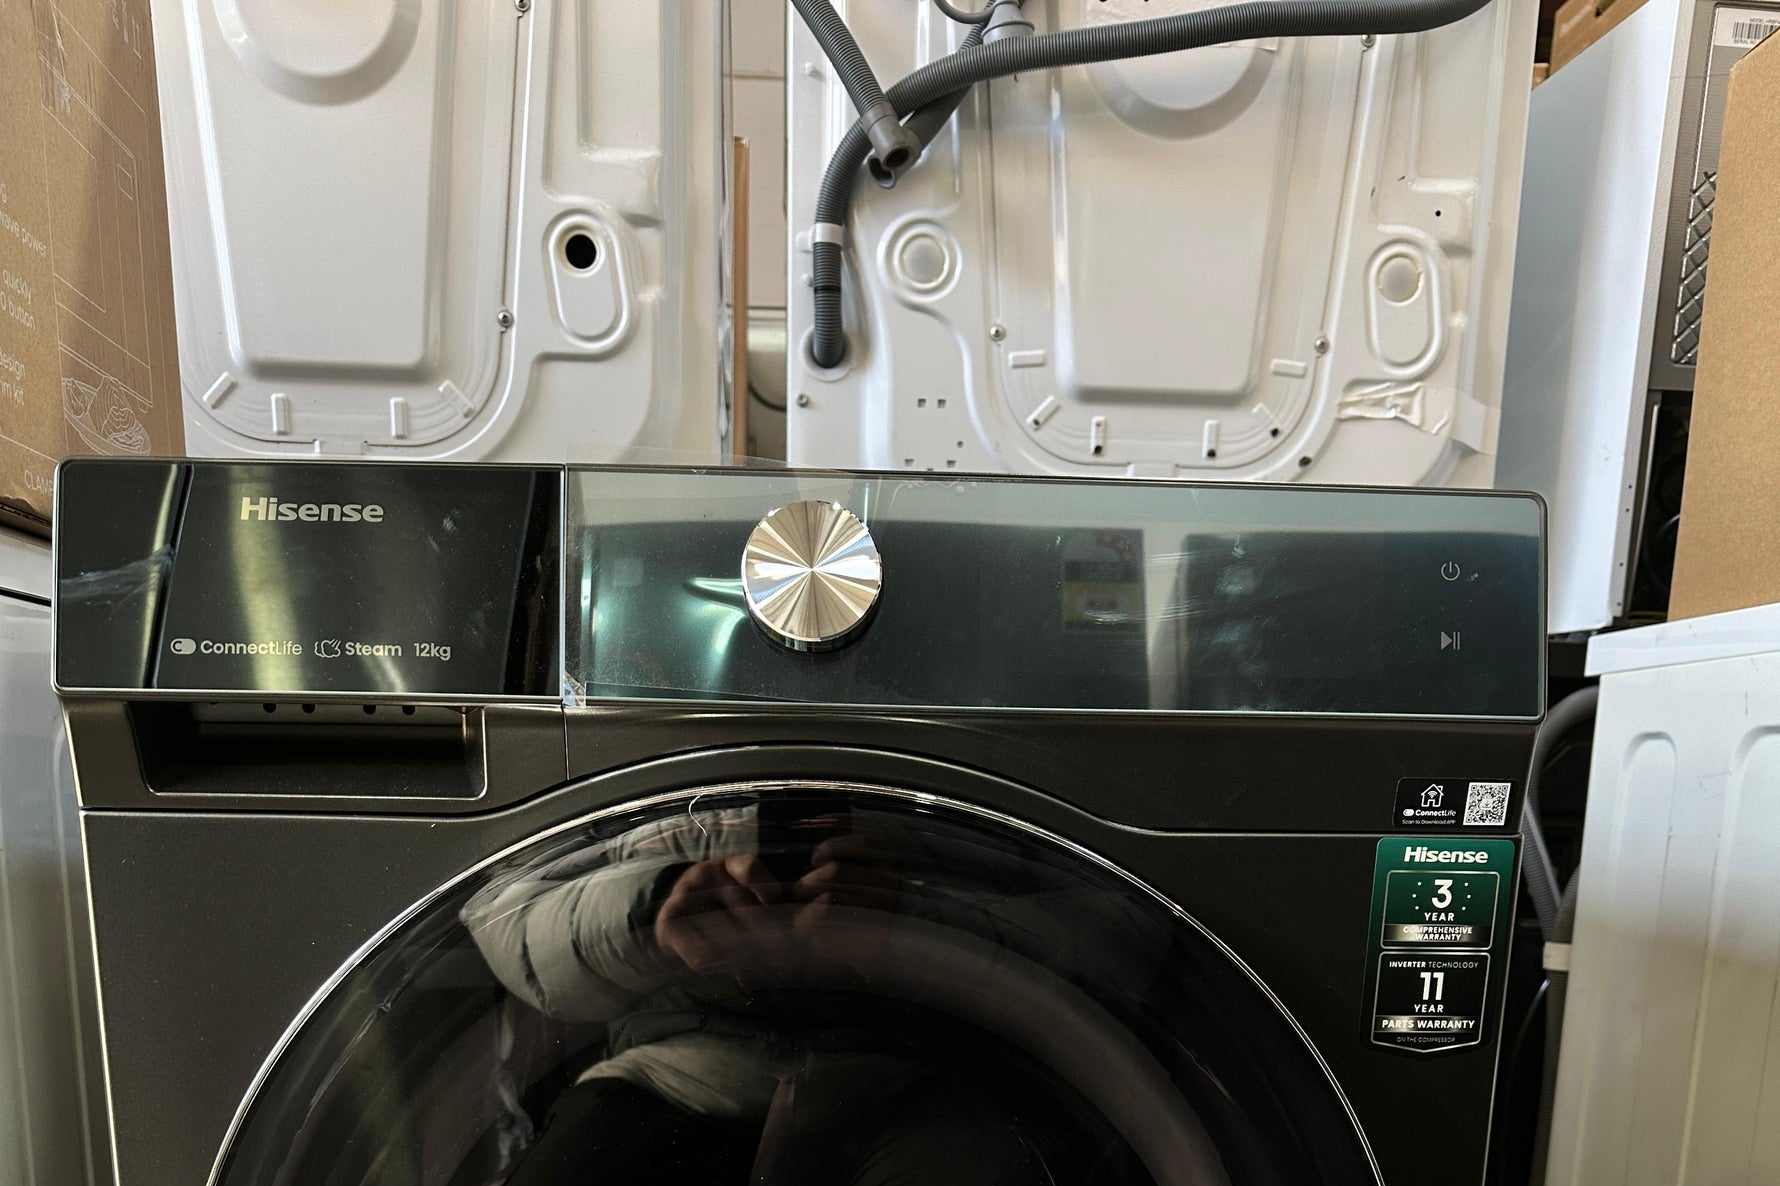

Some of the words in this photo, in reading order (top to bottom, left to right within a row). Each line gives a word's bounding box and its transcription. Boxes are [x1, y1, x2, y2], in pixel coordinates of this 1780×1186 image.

[21, 228, 46, 258] power
[3, 269, 31, 305] quickly
[9, 296, 35, 330] button
[240, 497, 384, 522] Hisense
[200, 640, 302, 655] ConnectLife
[345, 642, 402, 656] Steam
[413, 643, 451, 661] 12kg
[1415, 809, 1456, 817] ConnectLife
[1404, 846, 1489, 864] Hisense
[1431, 879, 1453, 909] 3
[1424, 912, 1455, 921] YEAR
[1403, 926, 1473, 934] COMPREHENSIVE
[1420, 972, 1444, 1000] 11
[1414, 1004, 1444, 1013] YEAR
[1382, 1020, 1414, 1029] PARTS
[1417, 1020, 1475, 1029] WARRANTY
